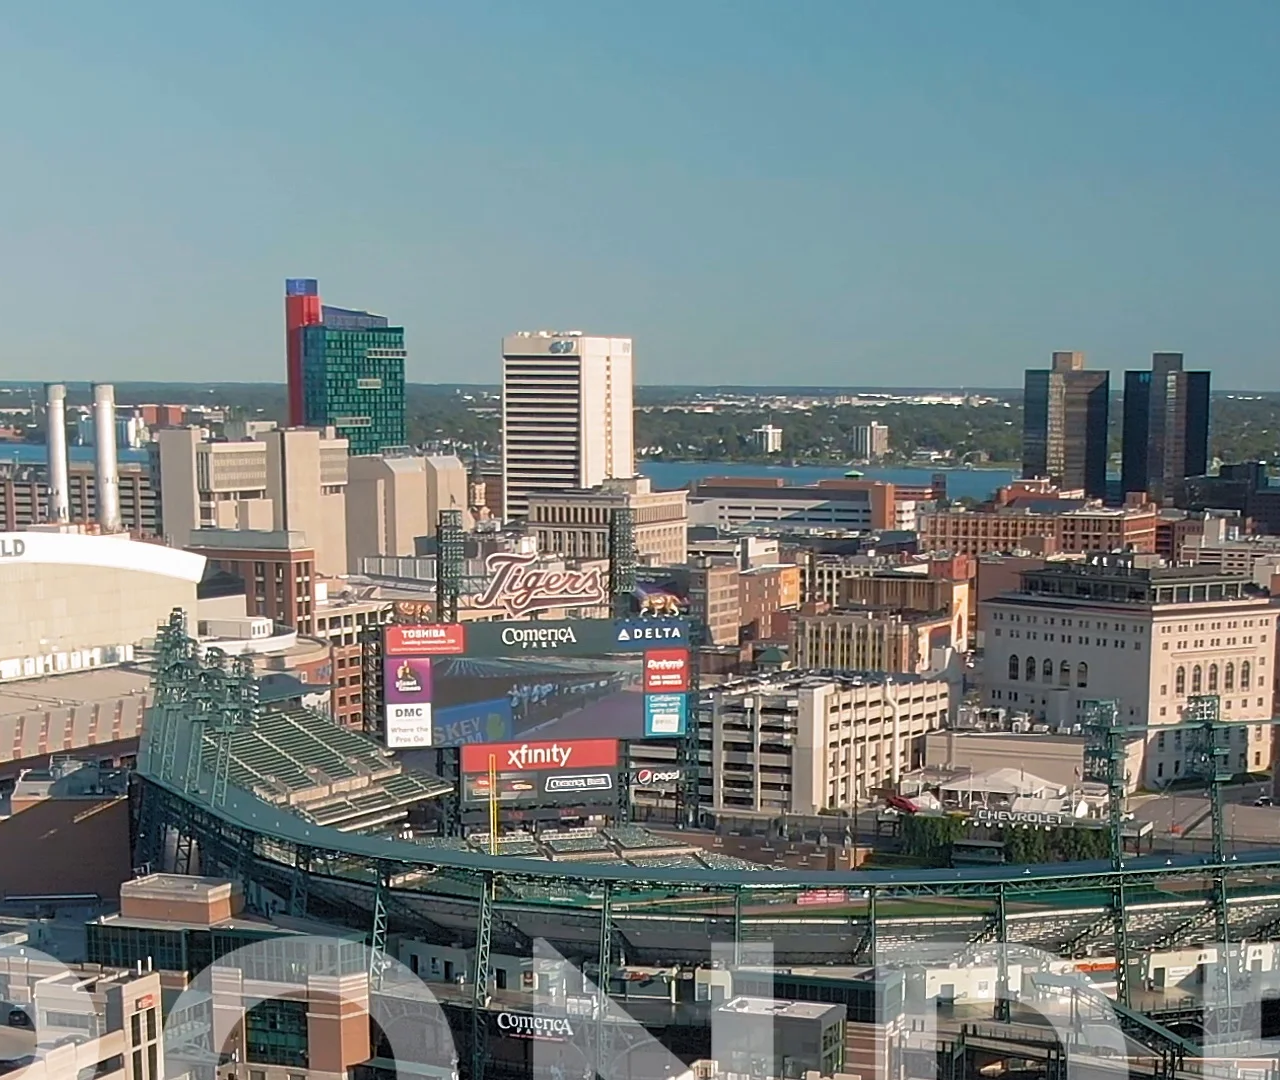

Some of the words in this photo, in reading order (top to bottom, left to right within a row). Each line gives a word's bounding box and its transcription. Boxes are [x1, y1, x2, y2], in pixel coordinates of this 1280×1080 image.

[473, 553, 604, 619] Tigers
[401, 629, 446, 639] TOSHIBA
[634, 627, 681, 639] DELTA
[395, 708, 423, 718] DMC
[507, 744, 572, 769] xfinity
[979, 810, 1062, 824] CHEVROLET
